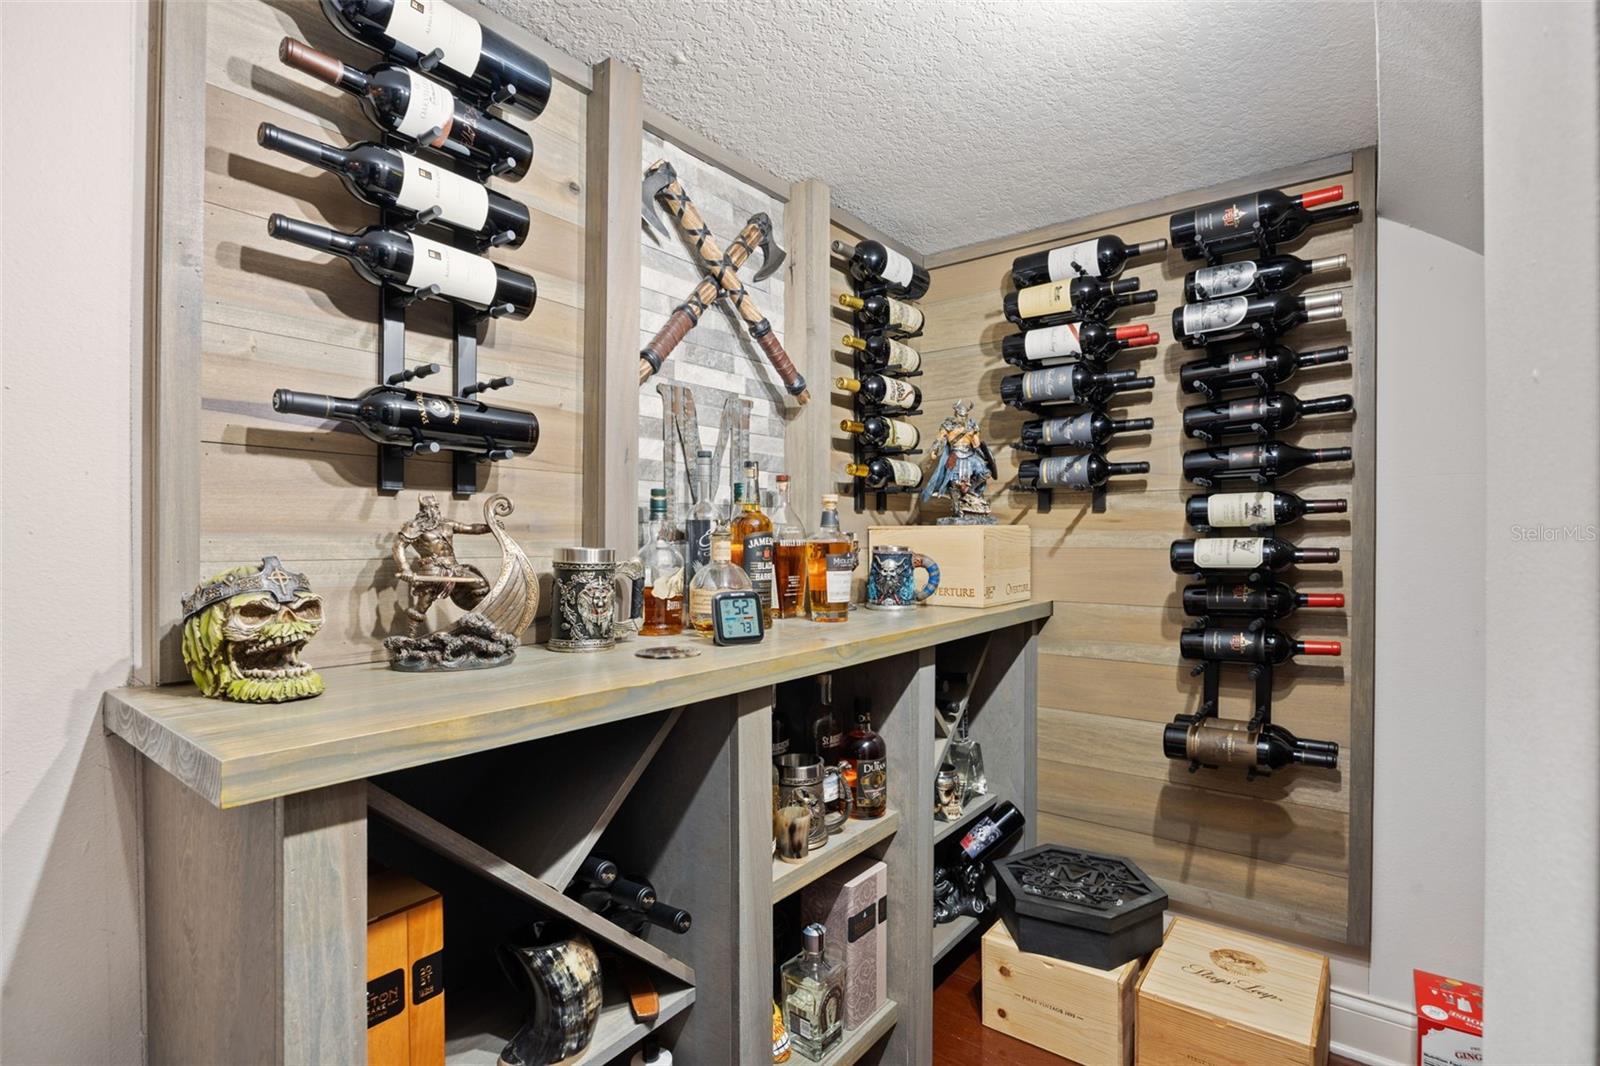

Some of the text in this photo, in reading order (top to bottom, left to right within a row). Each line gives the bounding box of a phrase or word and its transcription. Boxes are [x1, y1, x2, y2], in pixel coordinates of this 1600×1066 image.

[732, 600, 749, 615] 52
[740, 622, 752, 633] 73
[1455, 1051, 1483, 1061] GING
